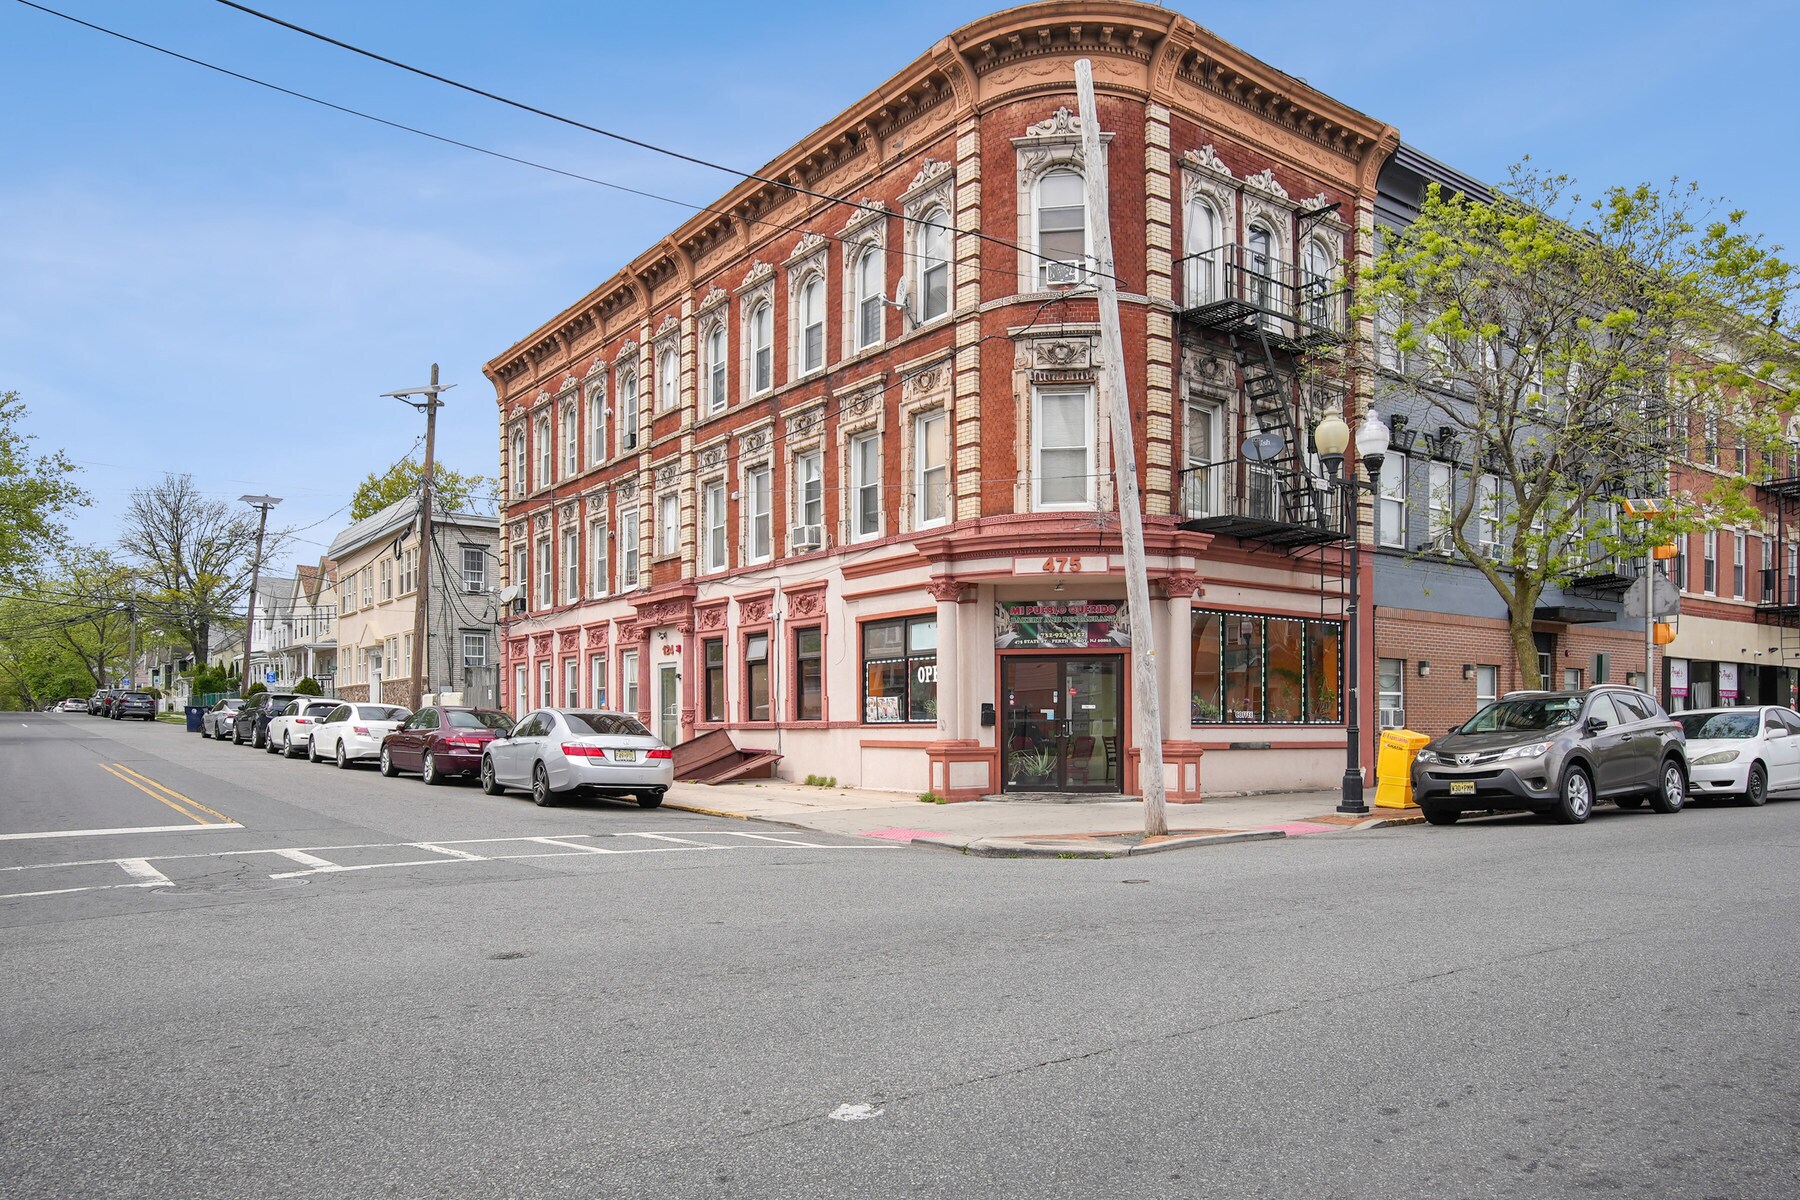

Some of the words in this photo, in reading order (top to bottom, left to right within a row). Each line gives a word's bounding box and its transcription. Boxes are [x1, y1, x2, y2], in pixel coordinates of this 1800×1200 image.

[1042, 555, 1082, 573] 475
[1010, 605, 1025, 615] MI
[1026, 605, 1067, 616] PUEBLO
[1068, 604, 1117, 614] QUERIDO
[1044, 615, 1062, 624] AND
[1235, 710, 1254, 718] COFFEE
